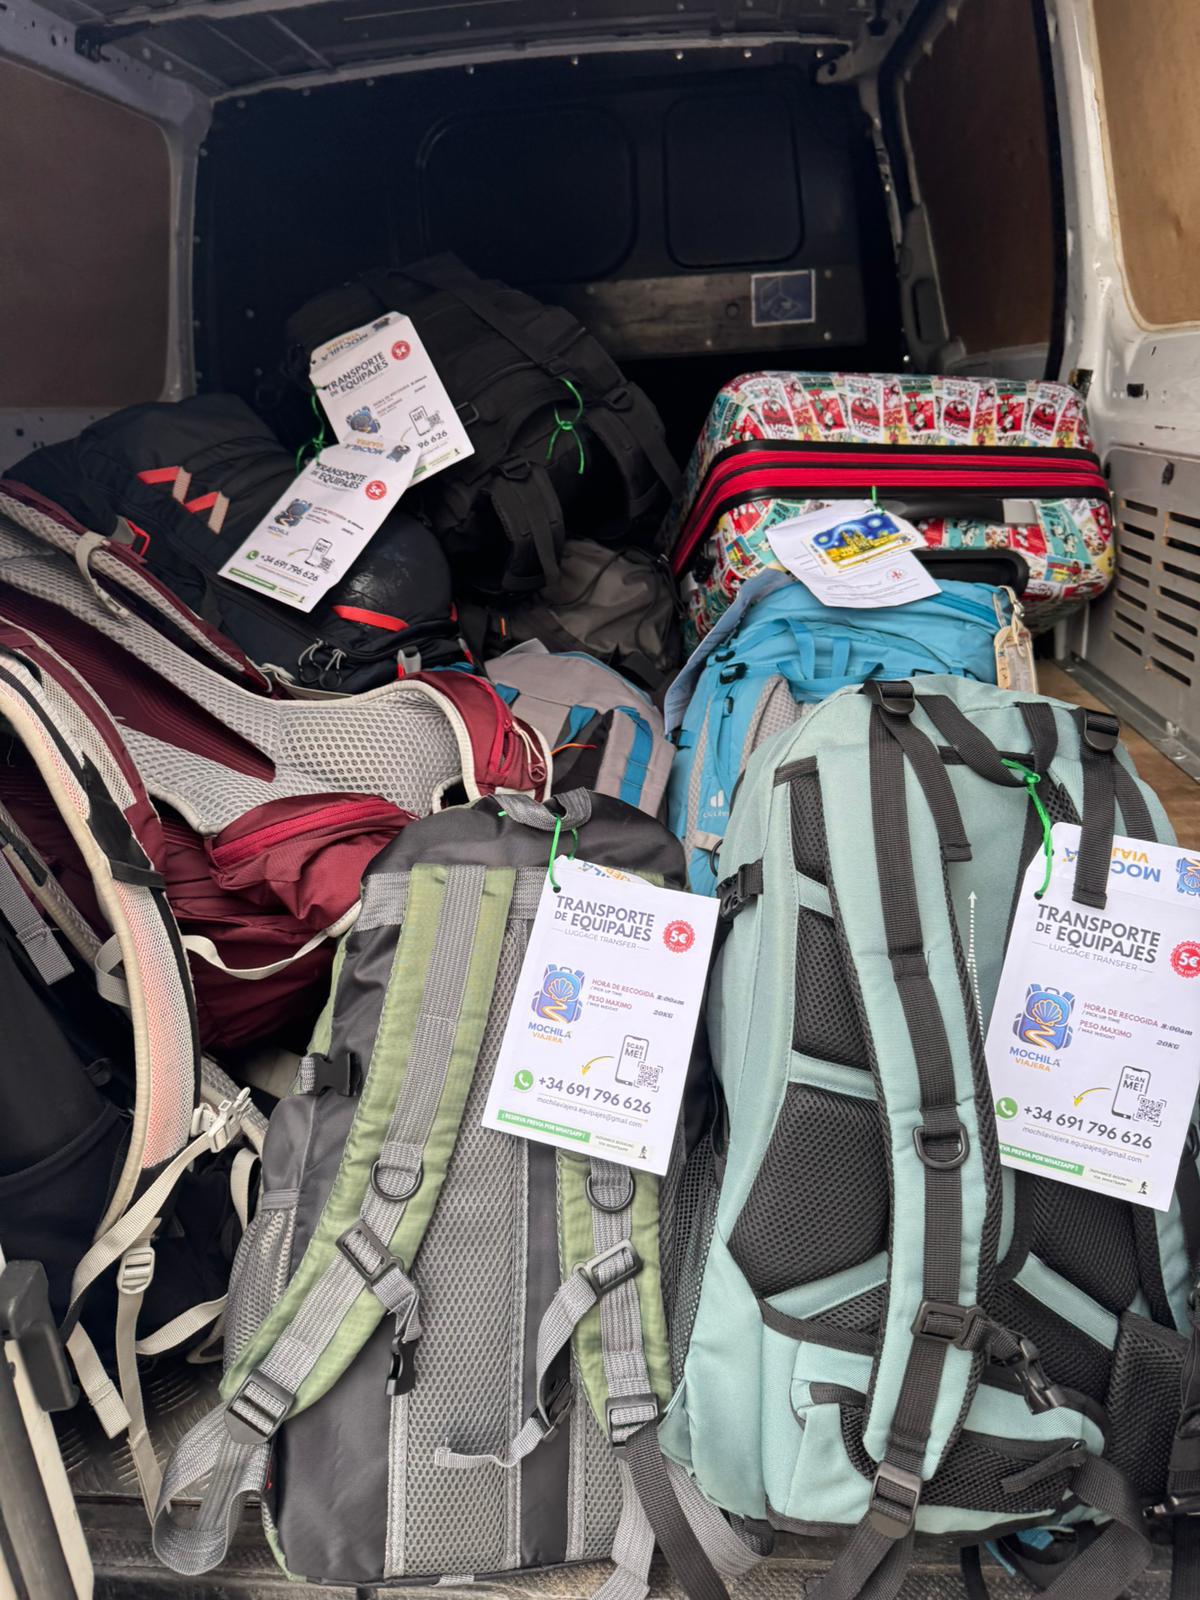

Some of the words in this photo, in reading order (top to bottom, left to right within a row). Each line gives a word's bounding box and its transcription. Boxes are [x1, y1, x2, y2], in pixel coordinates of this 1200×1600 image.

[326, 351, 386, 391] TRANSPORTE
[340, 359, 389, 393] EQUIPAJES
[430, 429, 448, 443] 626
[318, 472, 361, 489] EQUIPAJES
[261, 554, 274, 564] +34
[274, 558, 287, 569] 691
[287, 563, 302, 575] 796
[302, 570, 319, 582] 626
[1112, 847, 1149, 864] VIAJ
[556, 895, 656, 928] TRANSPORTE
[554, 911, 567, 922] DE
[570, 913, 653, 942] EQUIPAJES
[1038, 904, 1161, 948] TRANSPORTE
[565, 929, 598, 942] LUGGAGE
[600, 936, 637, 949] TRANSFER
[669, 930, 688, 945] 5€
[1035, 922, 1053, 934] DE
[1056, 926, 1158, 964] EQUIPAJES
[1049, 943, 1091, 960] LUGGAGE
[1092, 954, 1138, 972] TRANSFER
[1179, 952, 1199, 968] 5€
[588, 994, 605, 1003] PESO
[592, 978, 612, 989] HORA
[612, 983, 621, 991] DE
[621, 985, 655, 999] RECOGIDA
[1080, 1019, 1100, 1030] PESO
[1084, 1002, 1107, 1014] HORA
[1107, 1008, 1118, 1017] DE
[1119, 1011, 1159, 1027] RECOGIDA
[528, 1022, 572, 1039] MOCHILA
[532, 1031, 563, 1044] VIAJERA
[624, 1048, 643, 1060] ME!
[626, 1041, 645, 1051] SCAN
[1009, 1046, 1061, 1068] MOCHILA
[1015, 1057, 1051, 1072] VIAJERA
[1122, 1080, 1144, 1092] ME!
[1124, 1073, 1145, 1084] SCAN
[538, 1076, 563, 1092] +34
[566, 1082, 590, 1098] 691
[592, 1088, 620, 1106] 796
[622, 1098, 651, 1114] 626
[1024, 1106, 1052, 1123] +34
[1056, 1113, 1083, 1131] 691
[1086, 1120, 1117, 1140] 796
[1121, 1130, 1153, 1149] 626
[1022, 1125, 1143, 1164] mochilaviajera.equipajes@gmail.com
